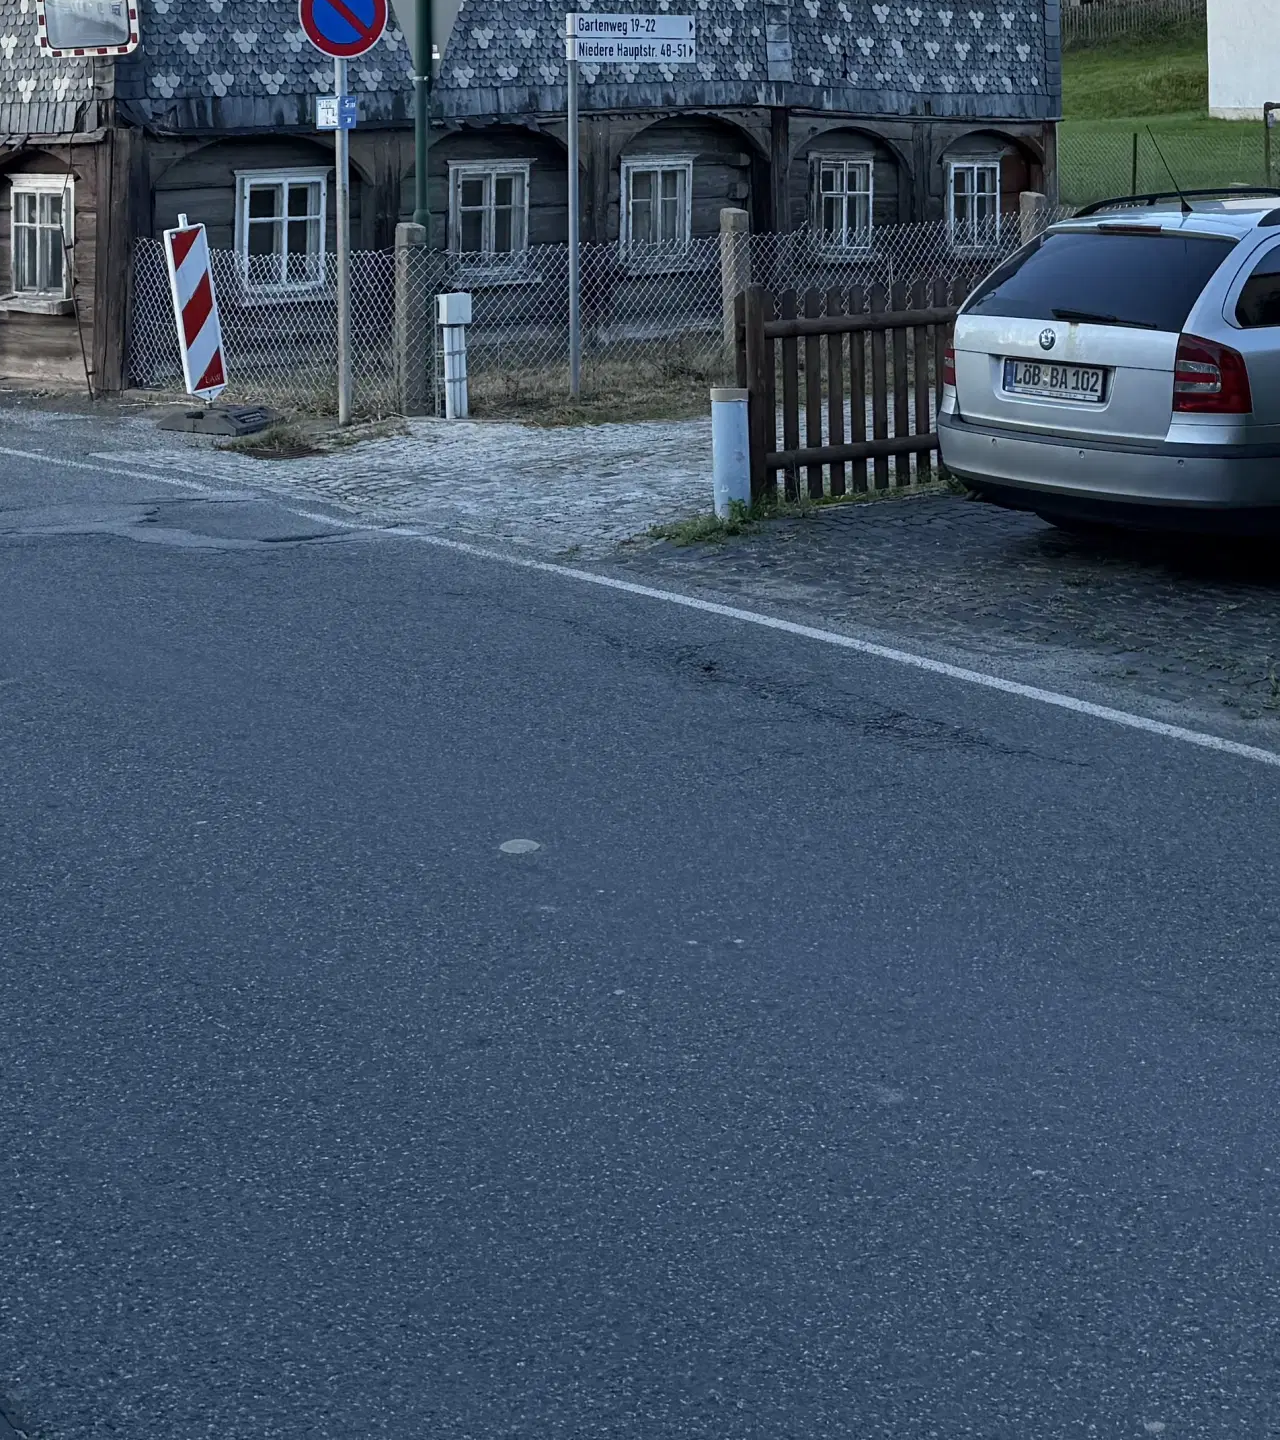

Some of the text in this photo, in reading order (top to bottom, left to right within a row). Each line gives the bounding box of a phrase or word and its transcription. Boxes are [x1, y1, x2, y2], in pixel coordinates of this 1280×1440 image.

[578, 17, 656, 35] Gartenweg 19-22
[578, 42, 687, 60] Niedere Hauptstr. 48-51
[1014, 363, 1100, 393] LÖB BA 102
